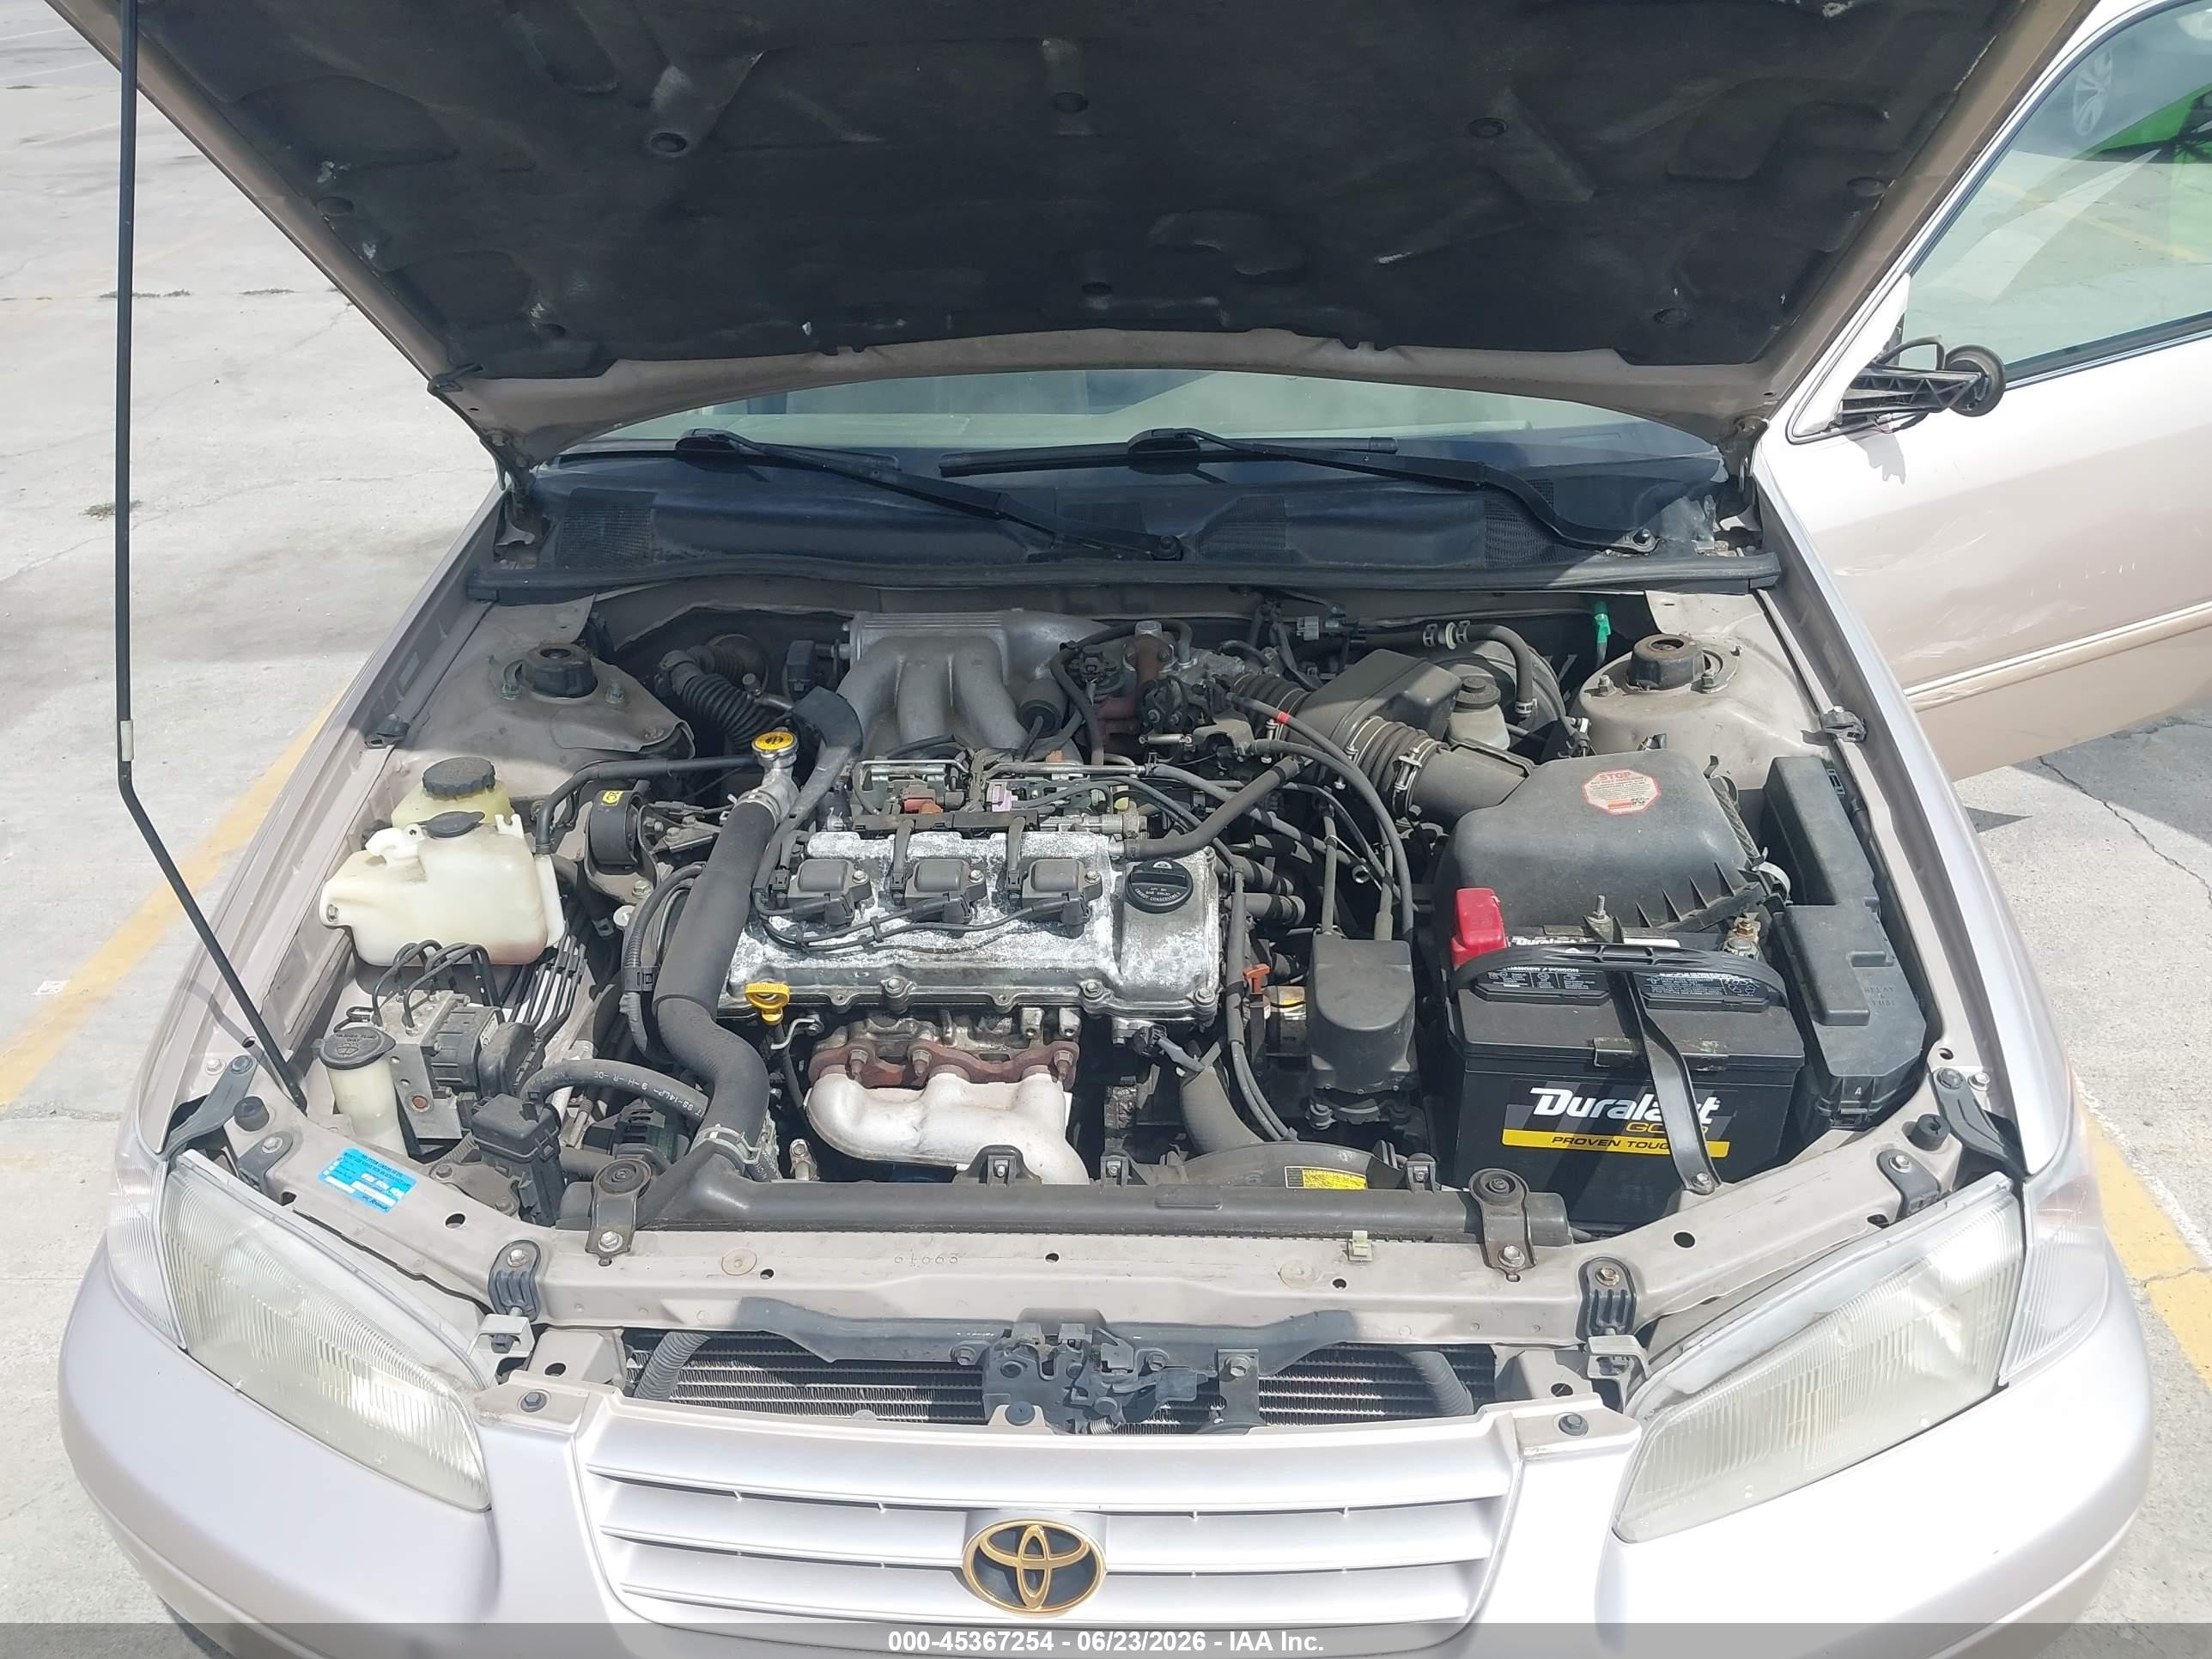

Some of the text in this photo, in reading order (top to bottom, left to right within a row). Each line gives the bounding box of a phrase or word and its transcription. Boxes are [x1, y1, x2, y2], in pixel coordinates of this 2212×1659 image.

[1599, 771, 1632, 781] STOP
[1855, 1086, 1862, 1095] A
[1552, 1136, 1671, 1150] PROVEN TOUG
